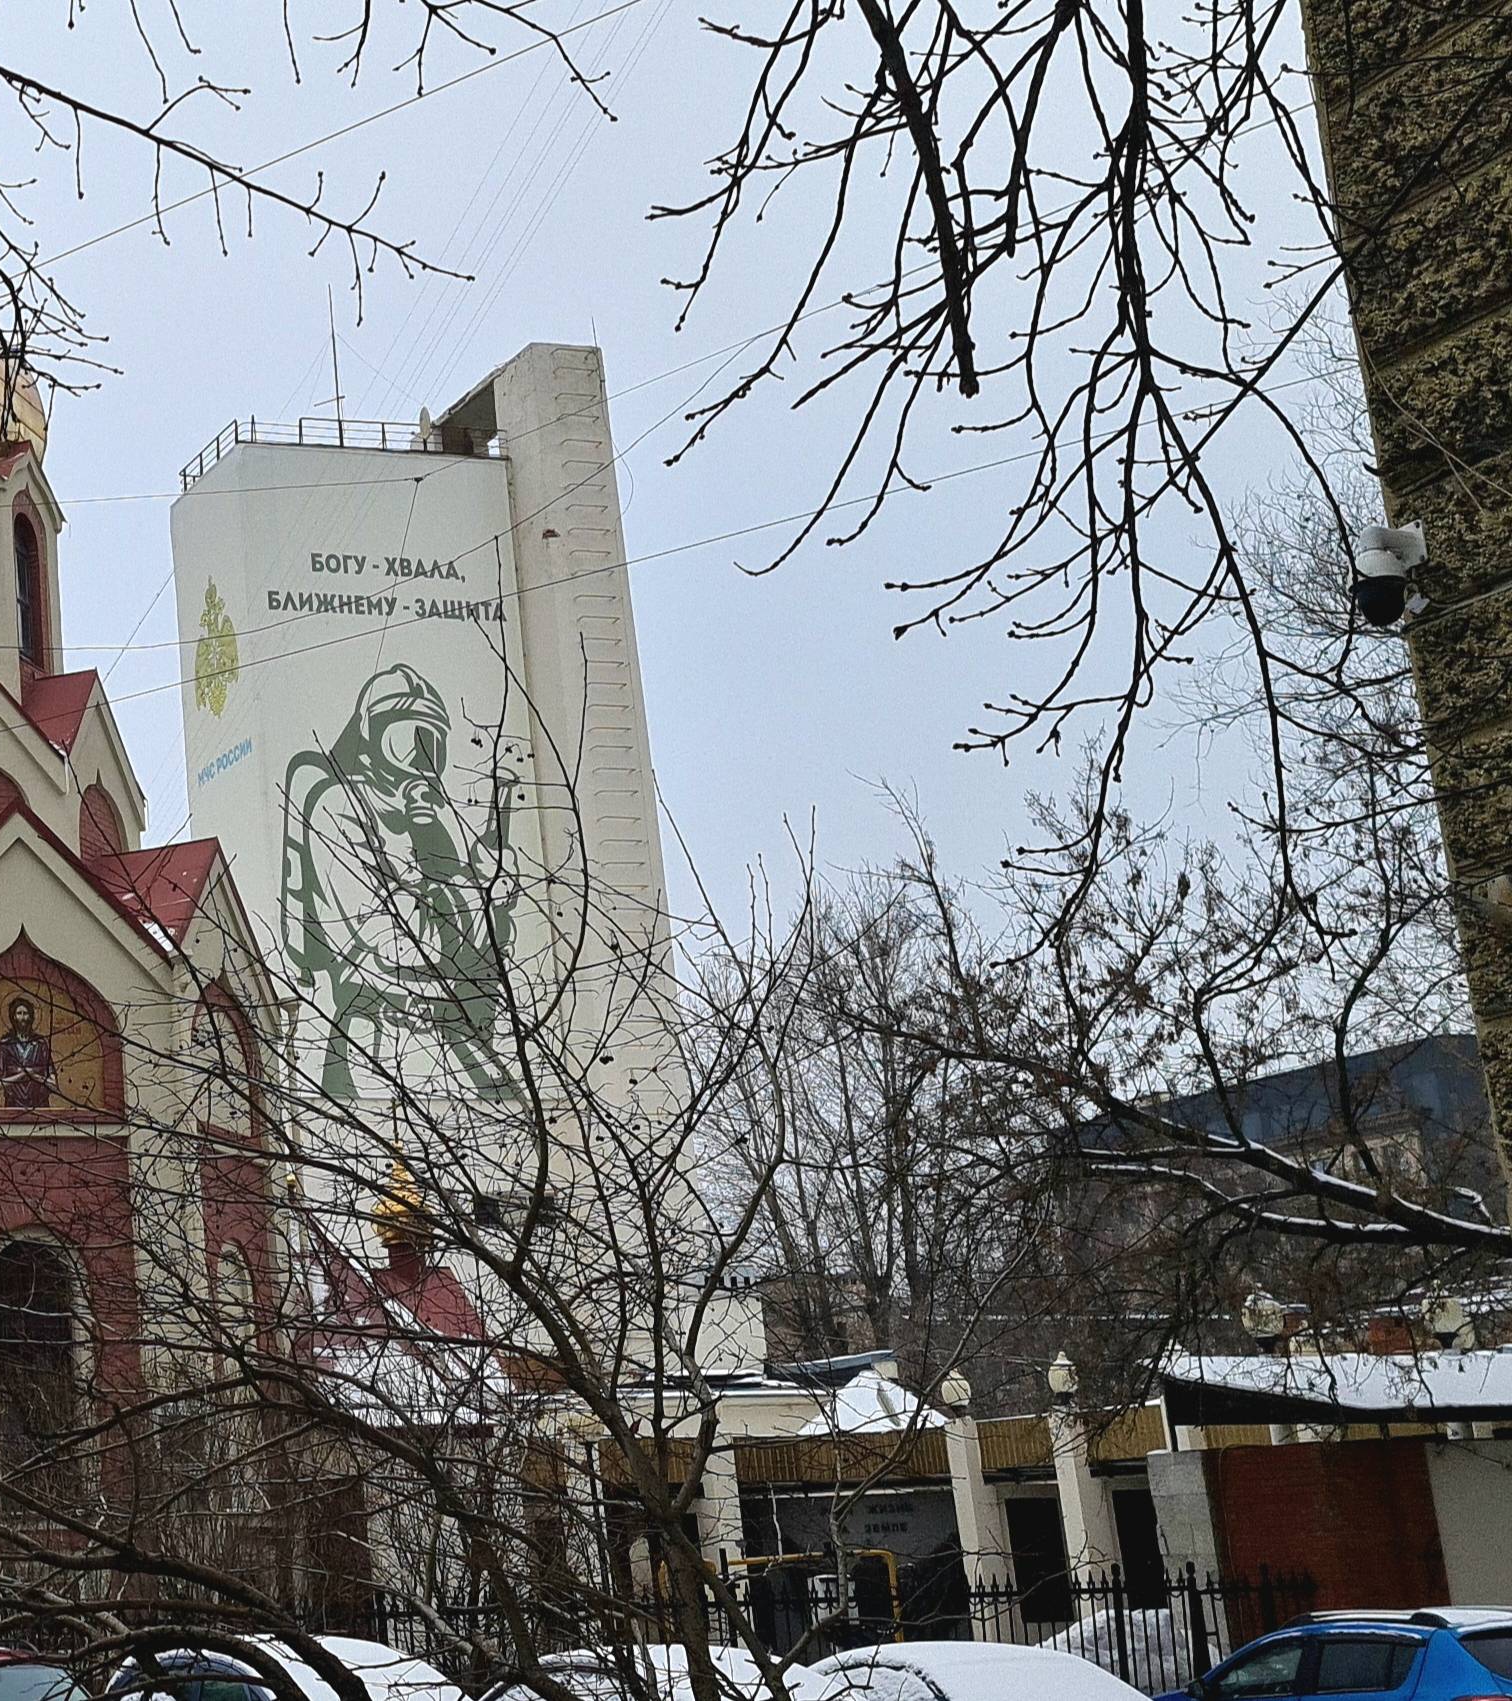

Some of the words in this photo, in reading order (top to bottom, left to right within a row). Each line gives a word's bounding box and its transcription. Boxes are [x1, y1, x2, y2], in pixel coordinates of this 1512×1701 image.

[310, 552, 367, 574] БОГУ
[384, 556, 466, 583] ХВАЛА,
[267, 590, 398, 617] БЛИЖНЕМУ
[414, 597, 507, 623] ЗАЩИТА
[216, 736, 253, 775] РОССИИ
